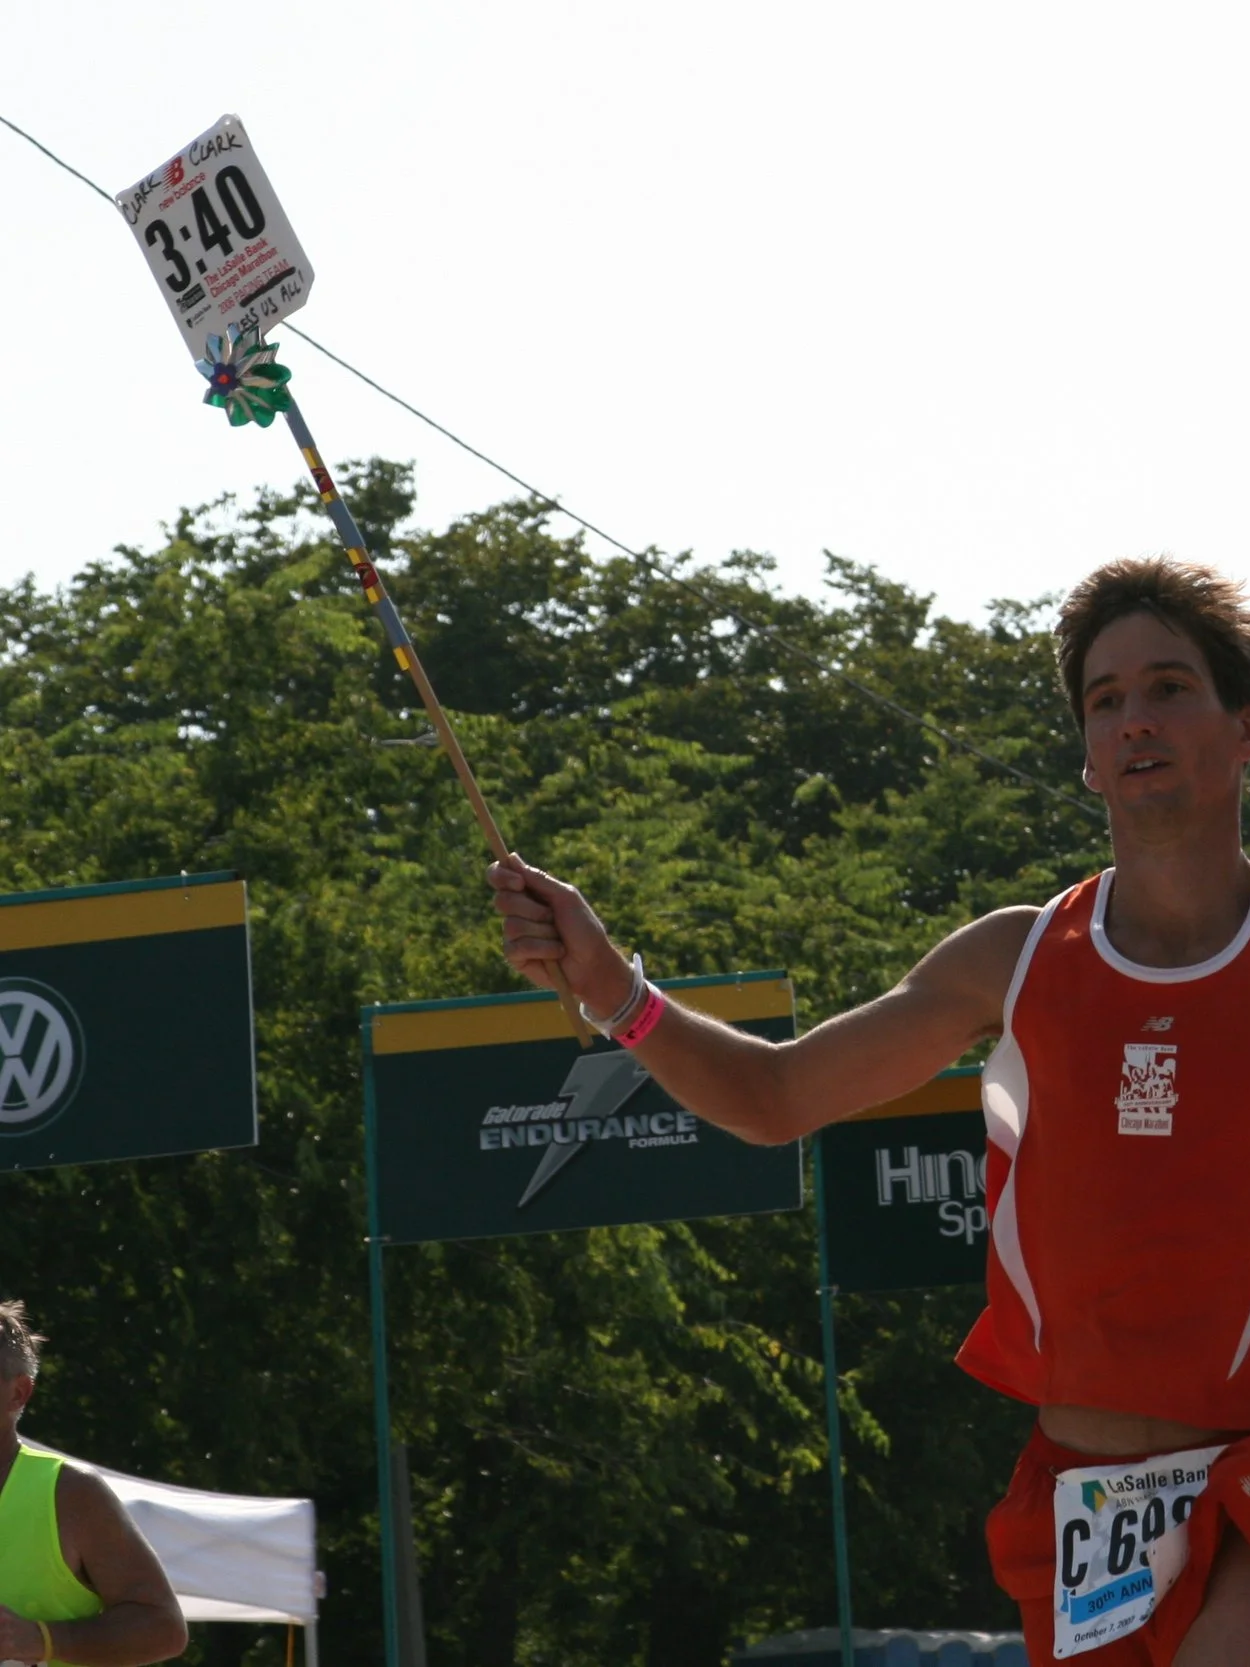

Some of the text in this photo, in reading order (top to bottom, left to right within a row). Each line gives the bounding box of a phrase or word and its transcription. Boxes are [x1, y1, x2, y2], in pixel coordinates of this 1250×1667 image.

[189, 132, 243, 166] CLARK
[122, 175, 162, 225] CLARK
[174, 172, 207, 200] balance
[144, 165, 266, 293] 3:40
[204, 238, 268, 287] The LaSalle Bank
[210, 247, 278, 298] Chicago Marathon
[260, 297, 279, 317] US
[482, 1101, 568, 1125] Gatorade
[480, 1111, 698, 1151] ENDURANCE
[628, 1133, 699, 1149] FORMULA
[1107, 1464, 1212, 1494] LaSalle Ban
[1061, 1518, 1091, 1588] C
[1088, 1588, 1116, 1614] 30th
[1074, 1626, 1108, 1643] October
